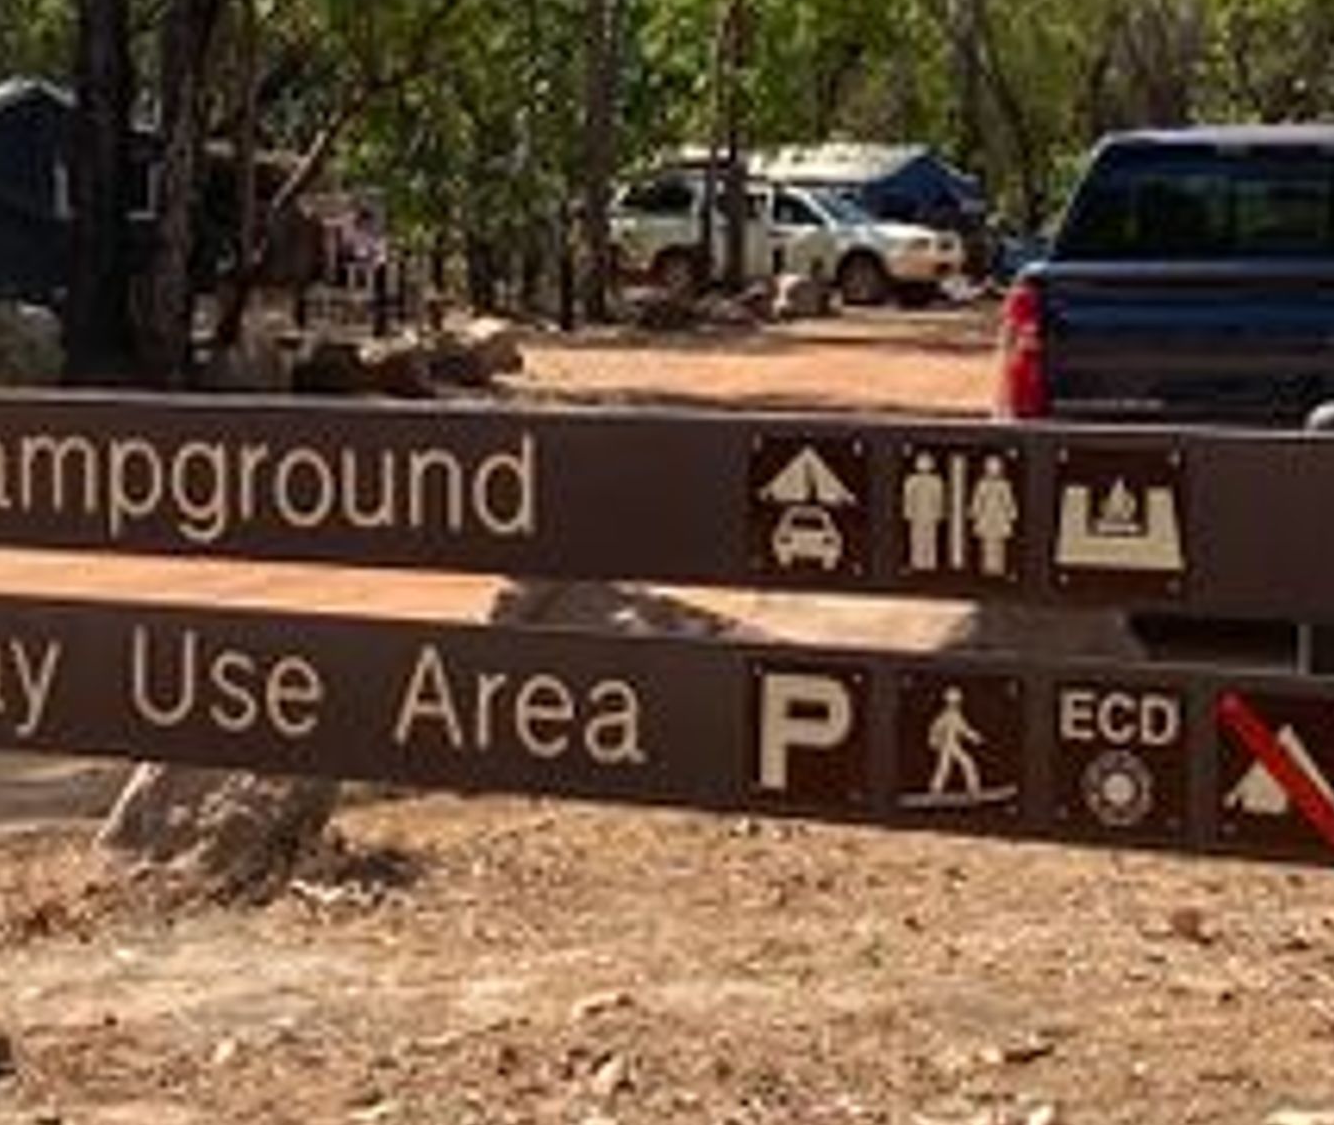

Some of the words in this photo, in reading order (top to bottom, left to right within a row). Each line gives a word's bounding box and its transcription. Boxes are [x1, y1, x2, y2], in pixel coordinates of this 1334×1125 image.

[132, 627, 323, 737] Use
[394, 646, 646, 764] Area
[760, 673, 851, 790] P
[1059, 690, 1179, 745] ECD
